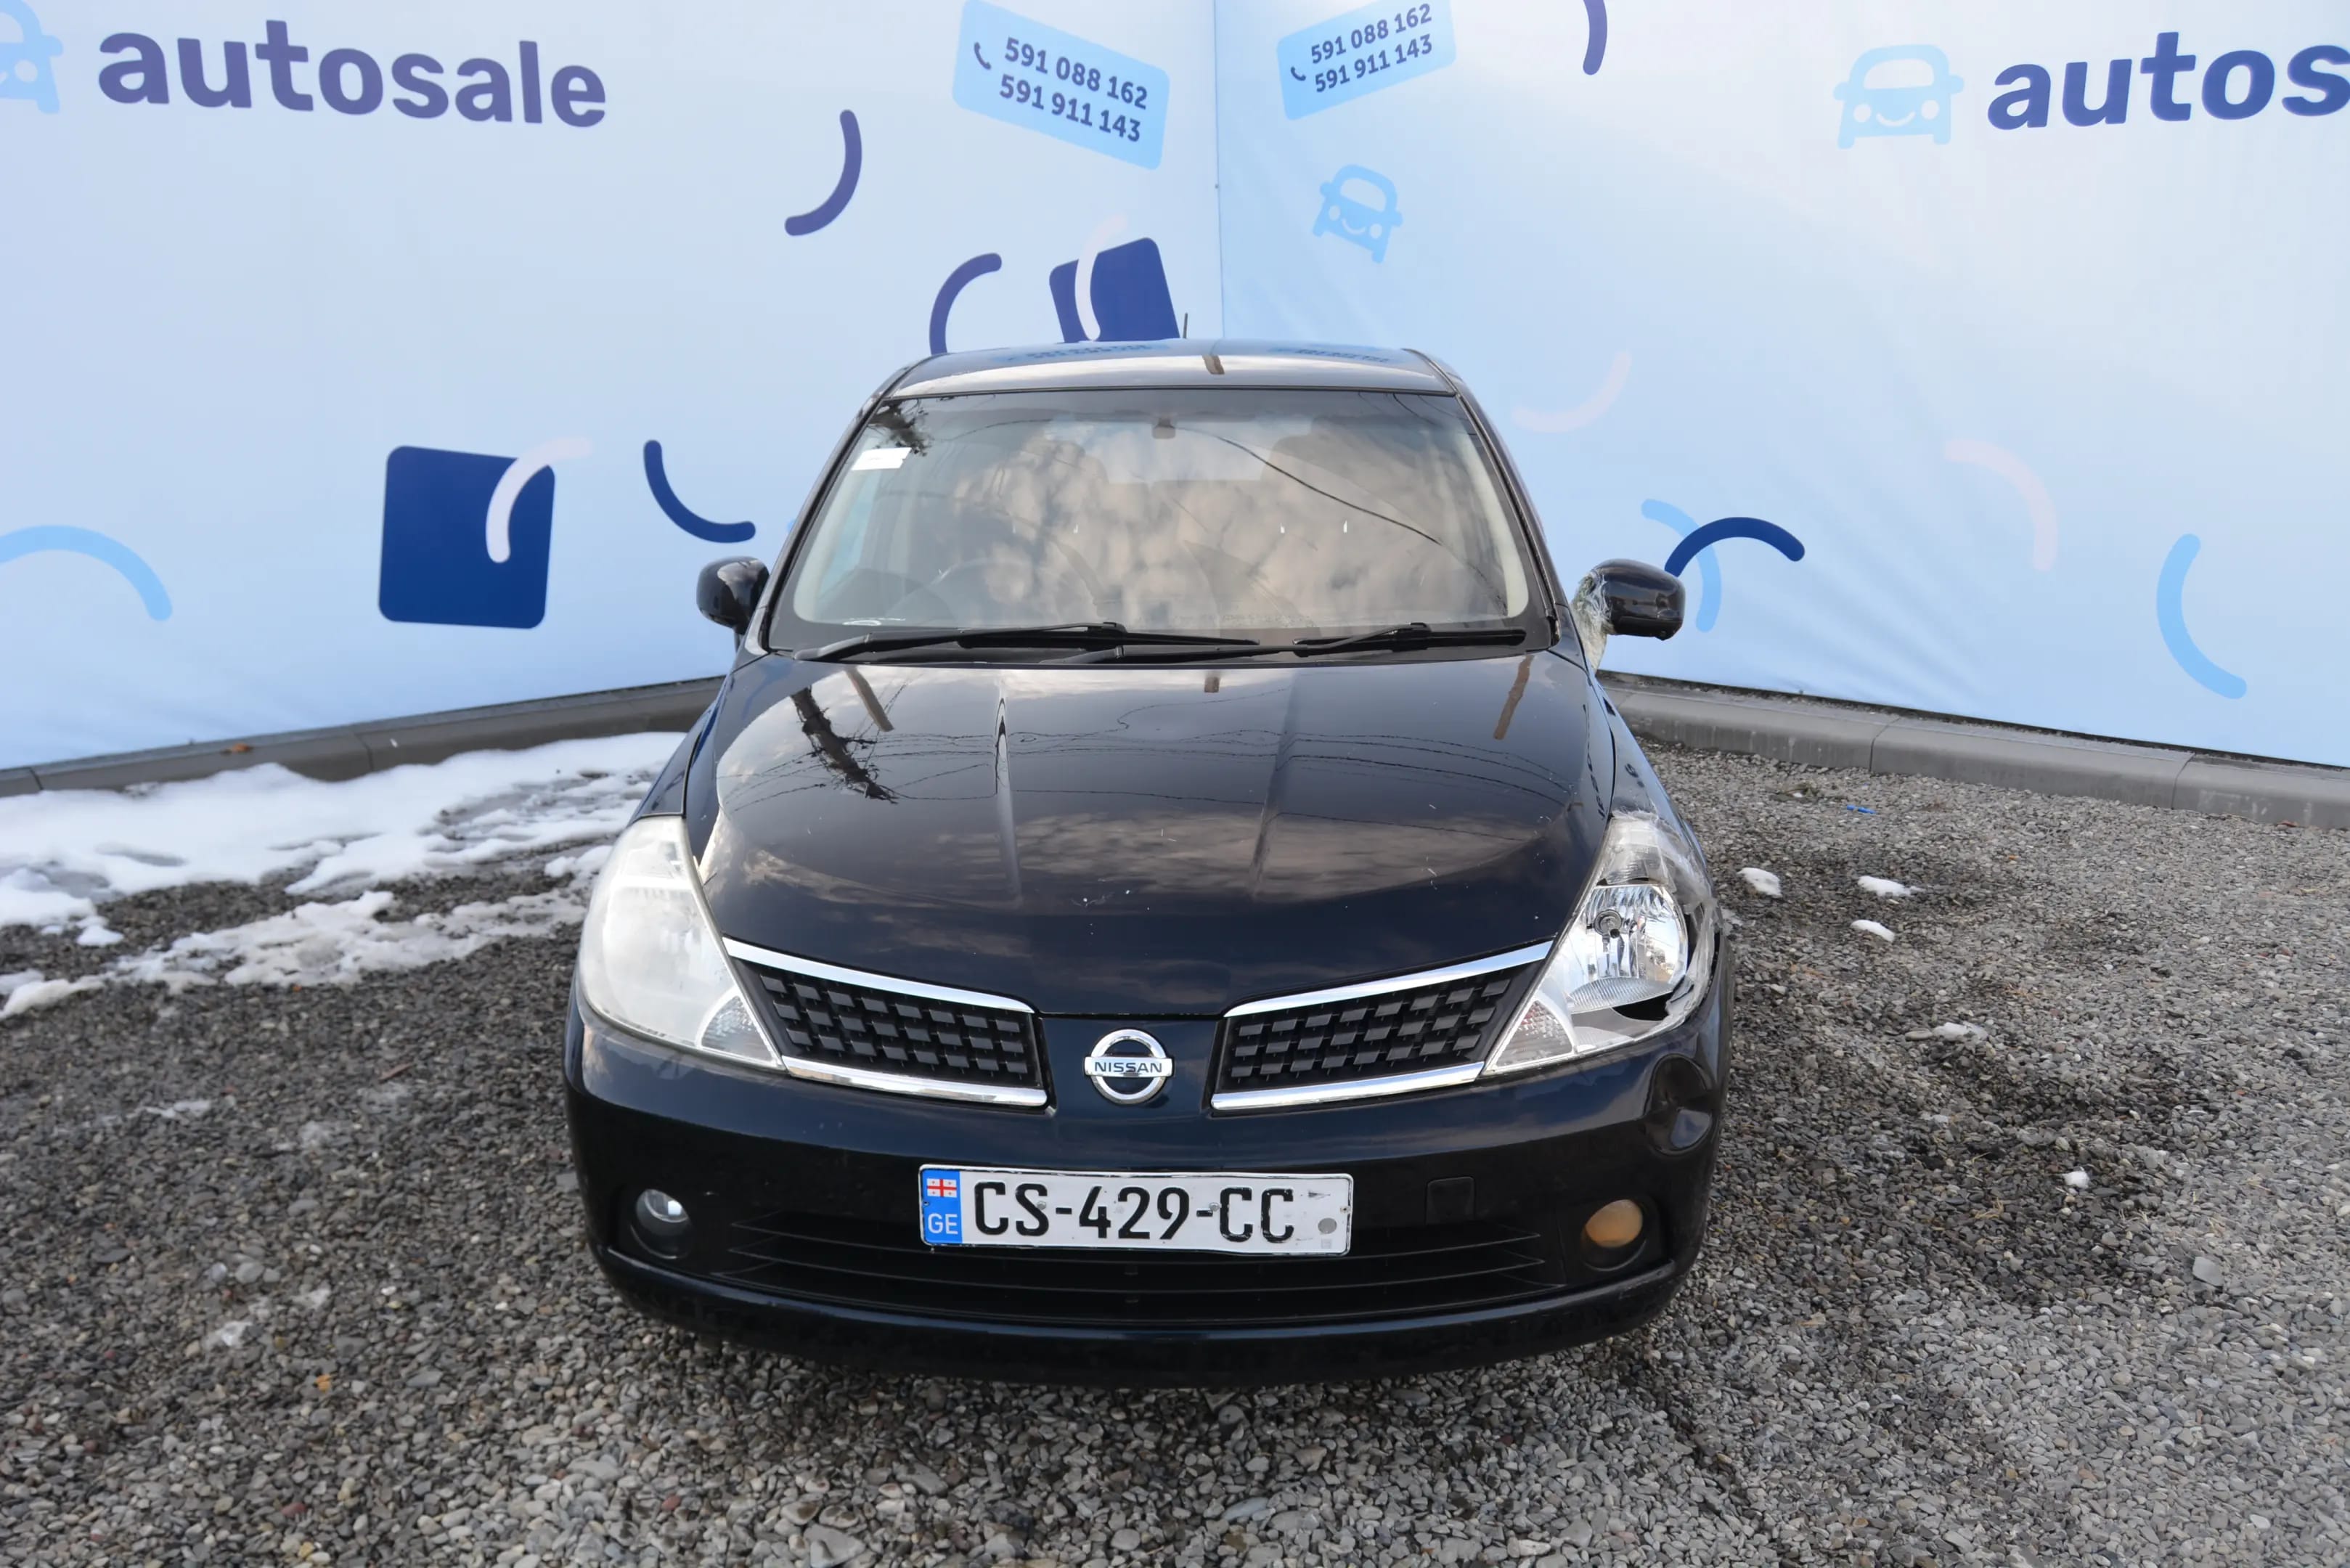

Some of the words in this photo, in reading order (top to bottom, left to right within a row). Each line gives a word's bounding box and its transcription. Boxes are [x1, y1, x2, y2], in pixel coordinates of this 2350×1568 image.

[1310, 36, 1347, 65] 591
[1350, 19, 1389, 49] 088
[1394, 3, 1432, 34] 162
[1315, 65, 1350, 93] 591
[1354, 50, 1391, 79] 911
[1395, 33, 1432, 65] 143
[98, 20, 606, 128] autosale
[1004, 36, 1048, 75] 591
[1056, 56, 1101, 92] 088
[1106, 75, 1148, 110] 162
[1987, 31, 2350, 131] autos
[999, 73, 1045, 110] 591
[1050, 91, 1093, 127] 911
[1098, 110, 1141, 142] 143
[1094, 1061, 1162, 1073] NISSAN
[928, 1212, 959, 1235] GE
[974, 1180, 1294, 1244] CS-429-CC
